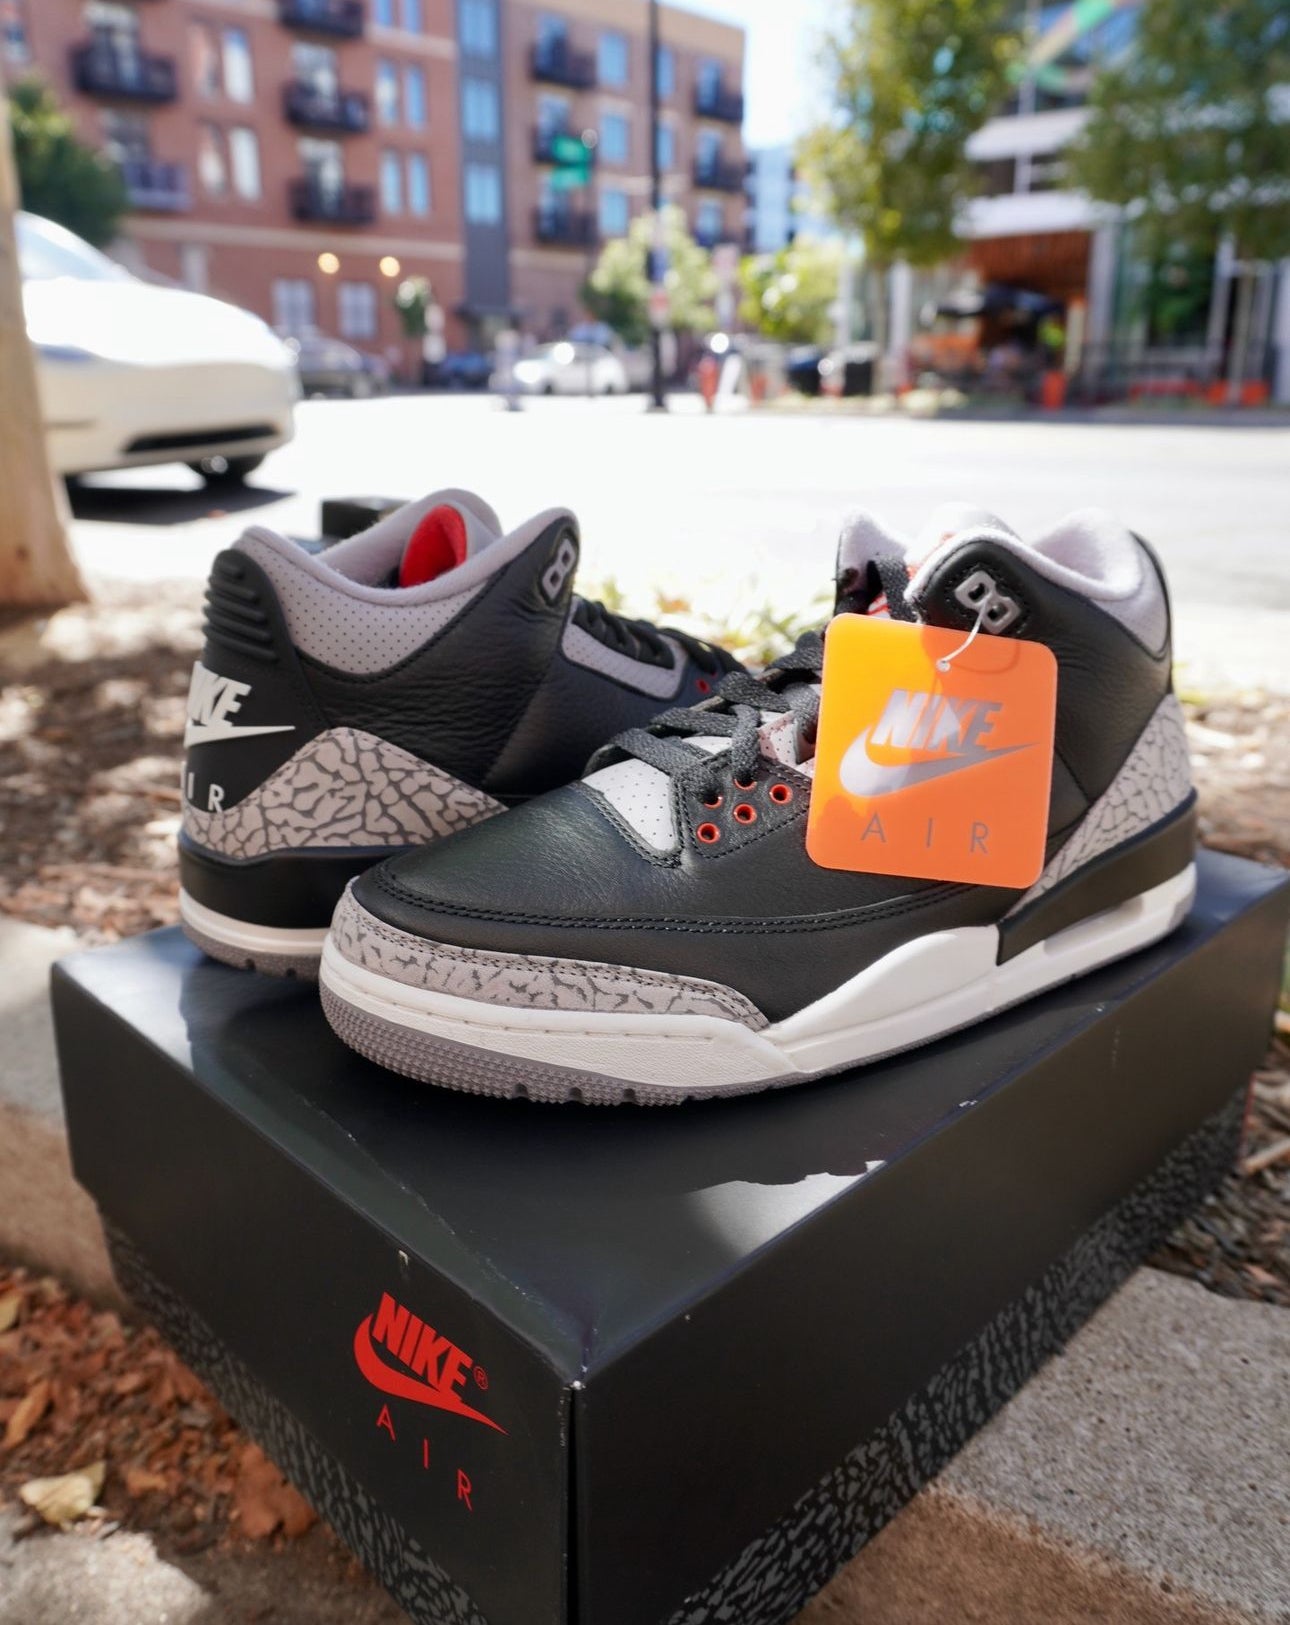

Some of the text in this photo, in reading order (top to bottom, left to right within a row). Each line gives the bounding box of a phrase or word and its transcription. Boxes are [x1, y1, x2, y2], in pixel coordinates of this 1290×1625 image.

[871, 689, 1003, 752] NIKE
[180, 761, 224, 812] IR
[860, 812, 989, 853] AIR
[376, 1404, 472, 1511] AIR
